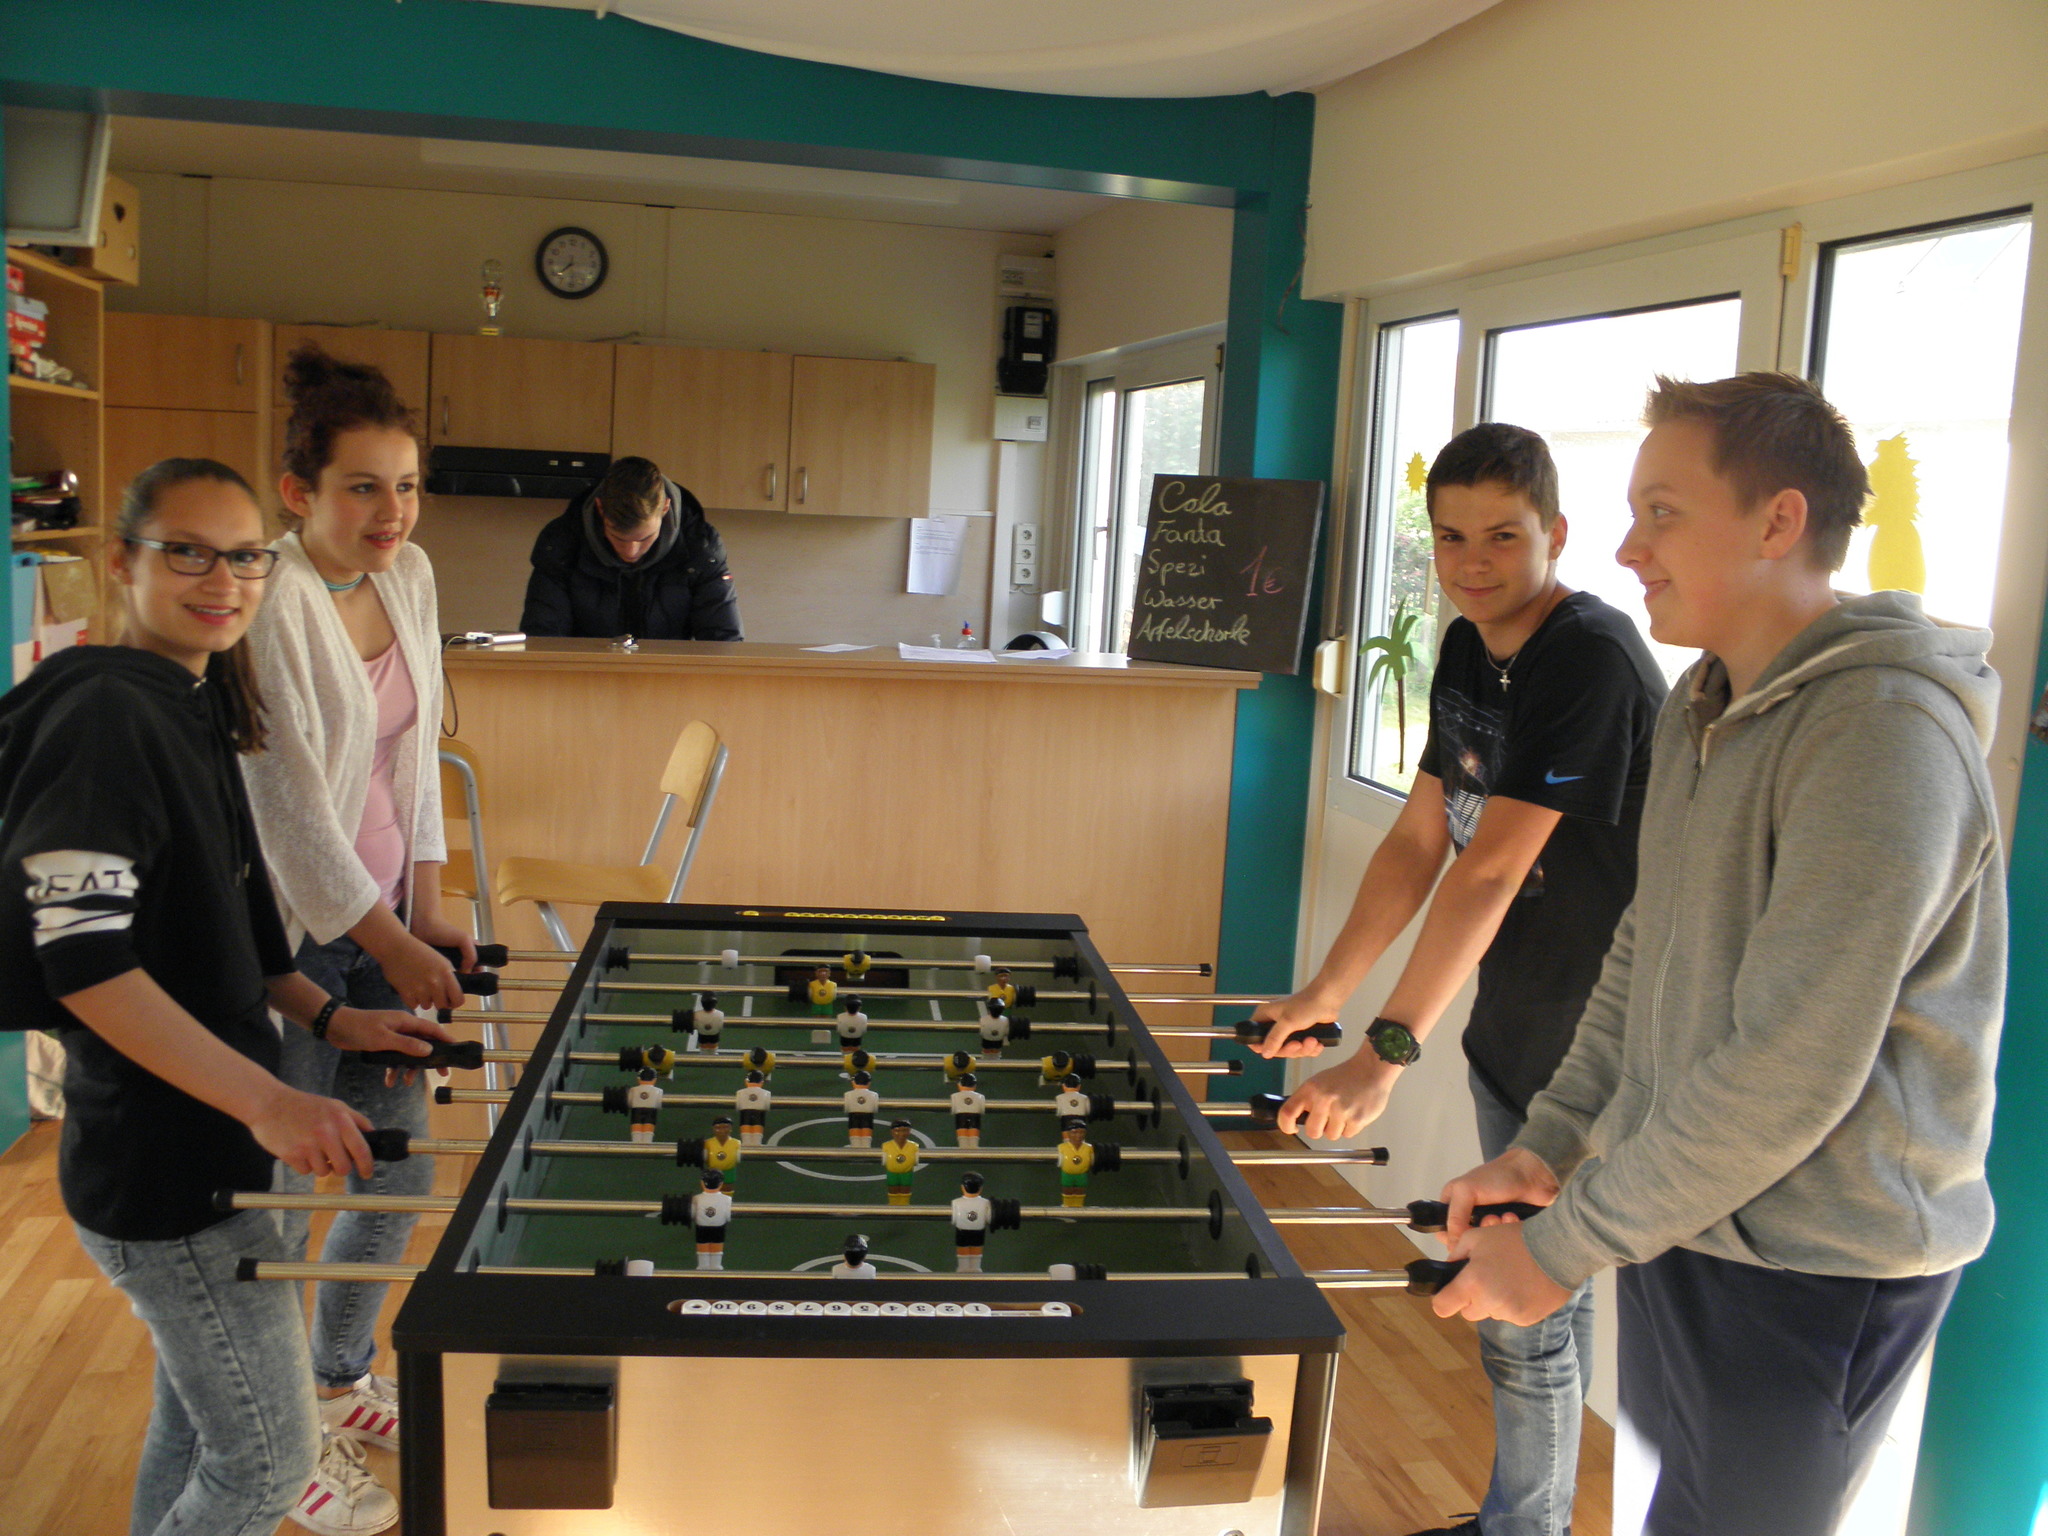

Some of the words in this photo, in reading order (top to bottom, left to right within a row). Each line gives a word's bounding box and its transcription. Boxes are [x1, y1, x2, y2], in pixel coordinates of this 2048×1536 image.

[1159, 481, 1232, 516] Cola
[1152, 518, 1226, 547] Fanta
[1147, 549, 1207, 586] Spezi
[1240, 545, 1285, 596] 1€
[1143, 589, 1223, 609] Wasser
